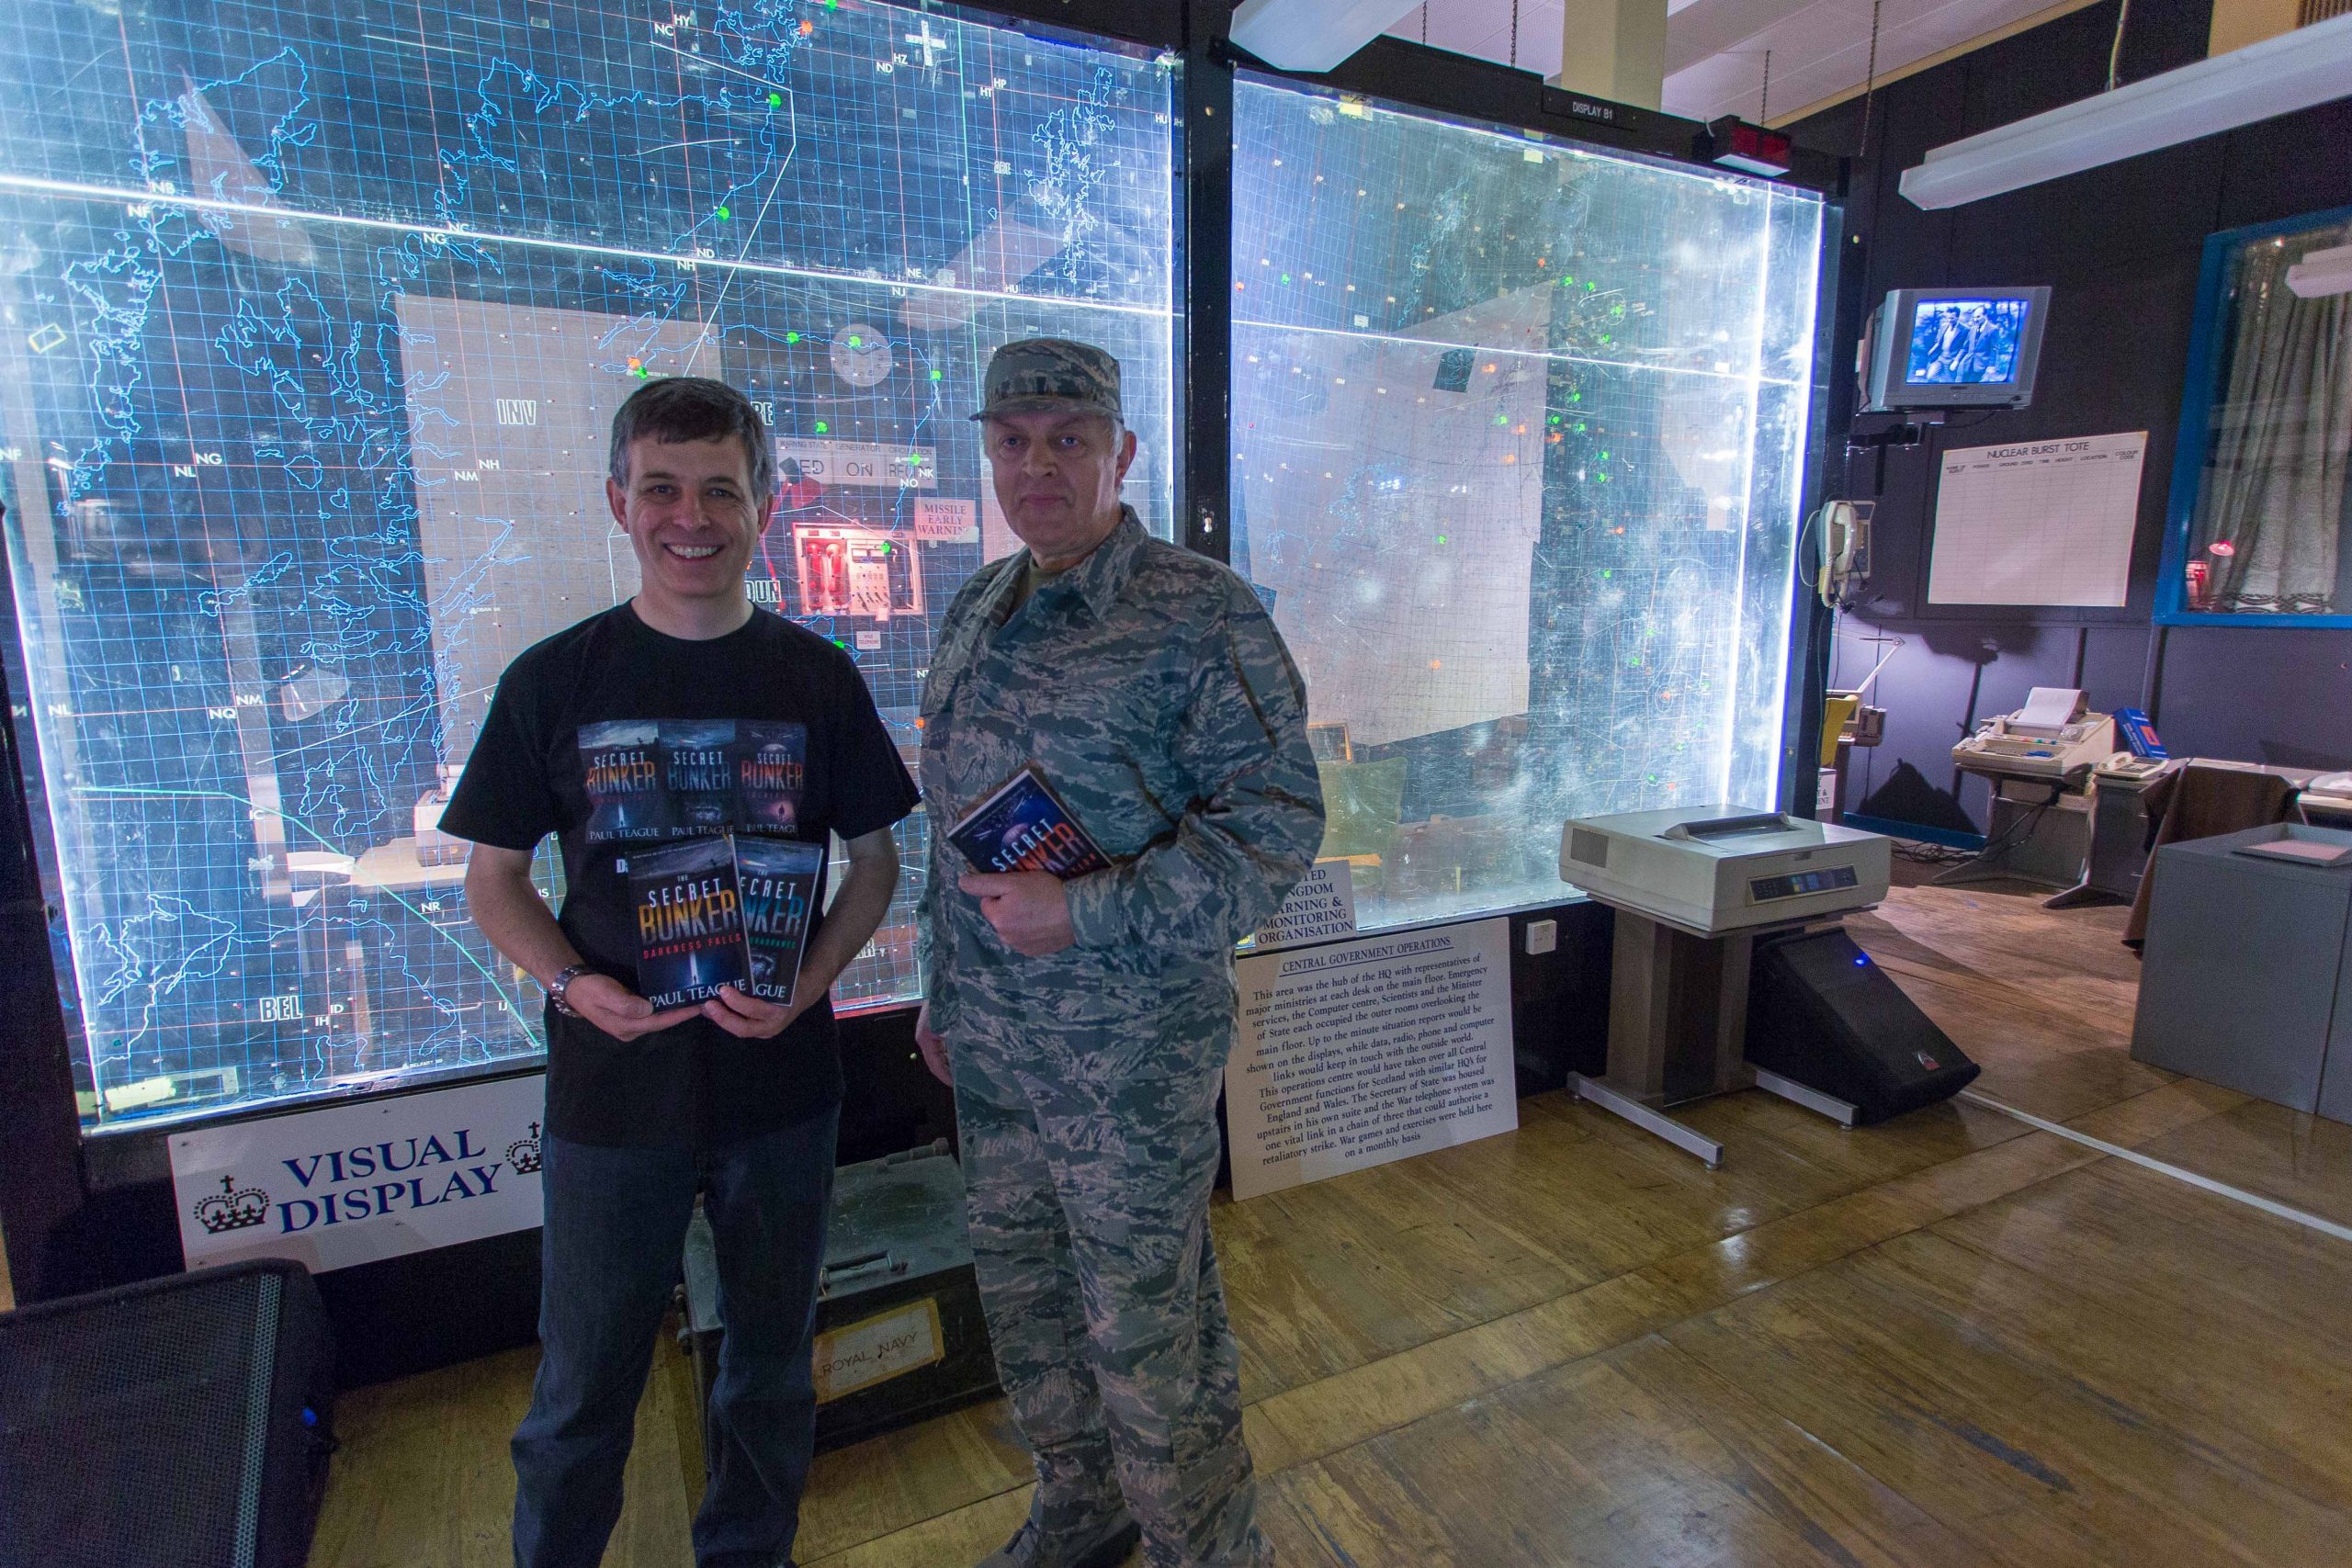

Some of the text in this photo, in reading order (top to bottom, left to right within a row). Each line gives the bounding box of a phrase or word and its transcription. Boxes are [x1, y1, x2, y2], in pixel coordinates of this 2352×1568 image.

[673, 15, 690, 26] HY
[654, 23, 674, 37] NC
[893, 51, 908, 65] HZ
[876, 62, 893, 73] ND
[993, 77, 1007, 89] HP
[979, 86, 992, 98] HT
[1572, 101, 1613, 119] DISPLAY B1
[149, 181, 175, 194] NB
[127, 203, 151, 219] NF
[423, 232, 447, 244] NG
[696, 247, 716, 258] ND
[676, 259, 695, 271] NH
[906, 267, 922, 279] NE
[891, 287, 906, 297] NJ
[1005, 284, 1019, 294] HU
[496, 399, 537, 425] INV
[0, 448, 22, 461] NF
[835, 443, 881, 452] GENERATOR
[1987, 441, 2090, 459] NUCLEAR BURST TOTE
[195, 453, 222, 465] NG
[479, 459, 500, 470] NH
[175, 466, 197, 478] NL
[799, 459, 824, 475] ED
[845, 461, 874, 477] ON
[919, 468, 934, 479] NK
[454, 470, 479, 482] NM
[899, 478, 919, 488] NO
[924, 503, 967, 515] MISSILE
[928, 514, 963, 525] EARLY
[919, 525, 965, 536] WARNIN
[236, 694, 264, 705] NM
[48, 705, 74, 716] NL
[209, 708, 237, 719] NQ
[594, 751, 645, 769] SECRET
[673, 750, 723, 765] SECRET
[757, 752, 791, 765] SECRET
[586, 761, 657, 794] BUNKER
[668, 762, 731, 792] BUNKER
[741, 760, 804, 790] BUNKER
[249, 810, 266, 820] IC
[590, 828, 661, 840] PAUL TEAGUE
[672, 827, 697, 836] PAUL
[991, 818, 1055, 872] SECRET
[1305, 869, 1327, 883] TED
[648, 878, 721, 908] SECRET
[741, 877, 797, 900] ECRET
[1286, 883, 1333, 899] NGDOM
[421, 902, 441, 913] NR
[1277, 896, 1343, 915] ARNING &
[638, 888, 738, 946] BUNKER
[745, 897, 806, 936] NKER
[1263, 908, 1347, 931] MONITORING
[1259, 920, 1354, 945] ORGANISATION
[643, 942, 702, 960] DARKNESS
[707, 932, 741, 947] FALLS
[1282, 936, 1451, 973] CENTRAL GOVERNMENT OPERATIONS
[1252, 953, 1481, 1001] This area was the hub of the HQ with representatives of
[755, 983, 786, 998] GUE
[1245, 966, 1488, 1017] major ministries at each desk on the main floor. Emergency
[498, 1001, 508, 1011] IJ
[648, 990, 685, 1008] PAUL
[1252, 979, 1483, 1028] services, the Computer centre, Scientists and the Minister
[259, 997, 304, 1022] BEL
[330, 1004, 345, 1014] ID
[1256, 990, 1480, 1041] of State each occupied the outer rooms overlooking the
[314, 1016, 330, 1027] IH
[1256, 1004, 1482, 1057] main floor. Up to the minute situation reports would be
[1246, 1018, 1495, 1074] shown on the displays, while data, radio, phone and computer
[1272, 1032, 1474, 1082] links would keep in touch with the outside world.
[282, 1129, 486, 1190] VISUAL
[277, 1162, 504, 1235] DISPLAY
[822, 1333, 918, 1374] ROYAL NAVY
